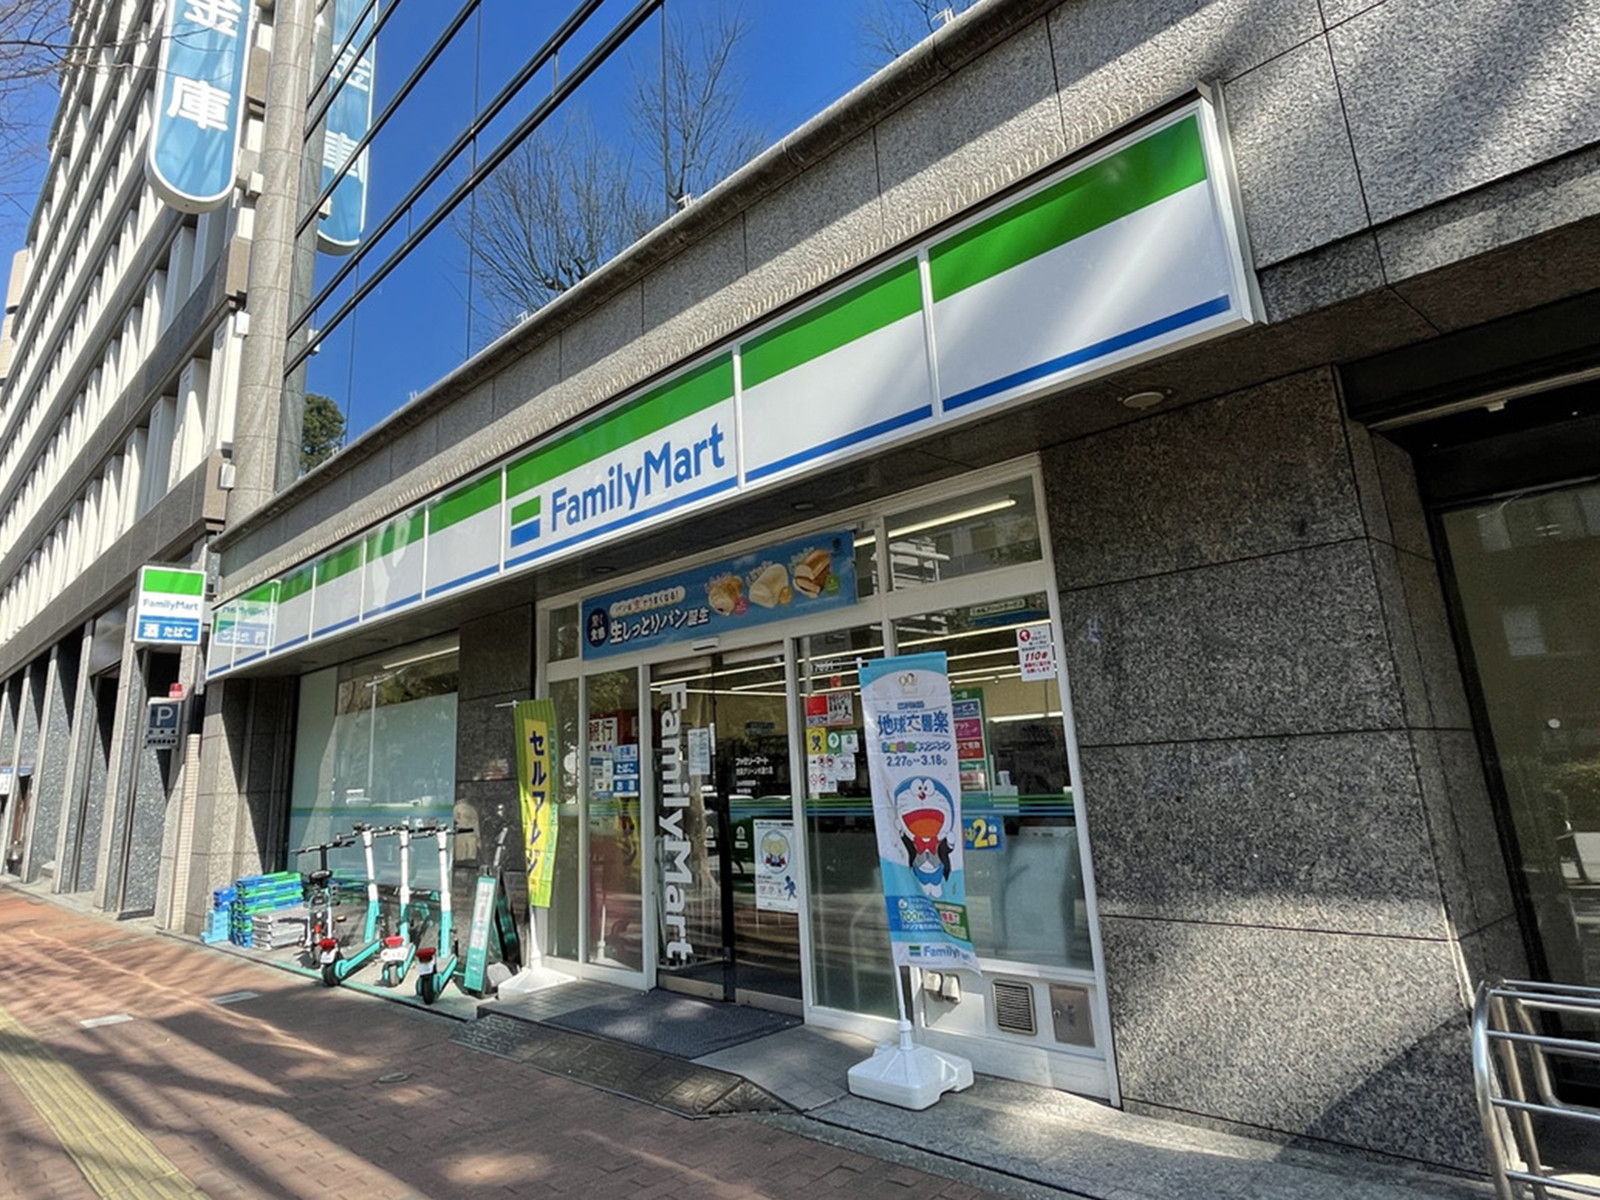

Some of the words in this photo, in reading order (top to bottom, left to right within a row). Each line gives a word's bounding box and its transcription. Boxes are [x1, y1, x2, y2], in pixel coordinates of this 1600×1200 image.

[551, 422, 725, 532] FamilyMart
[142, 598, 199, 612] FamilyMart
[163, 626, 195, 639] たばこ
[156, 706, 174, 727] P
[659, 682, 694, 962] FamilyMart
